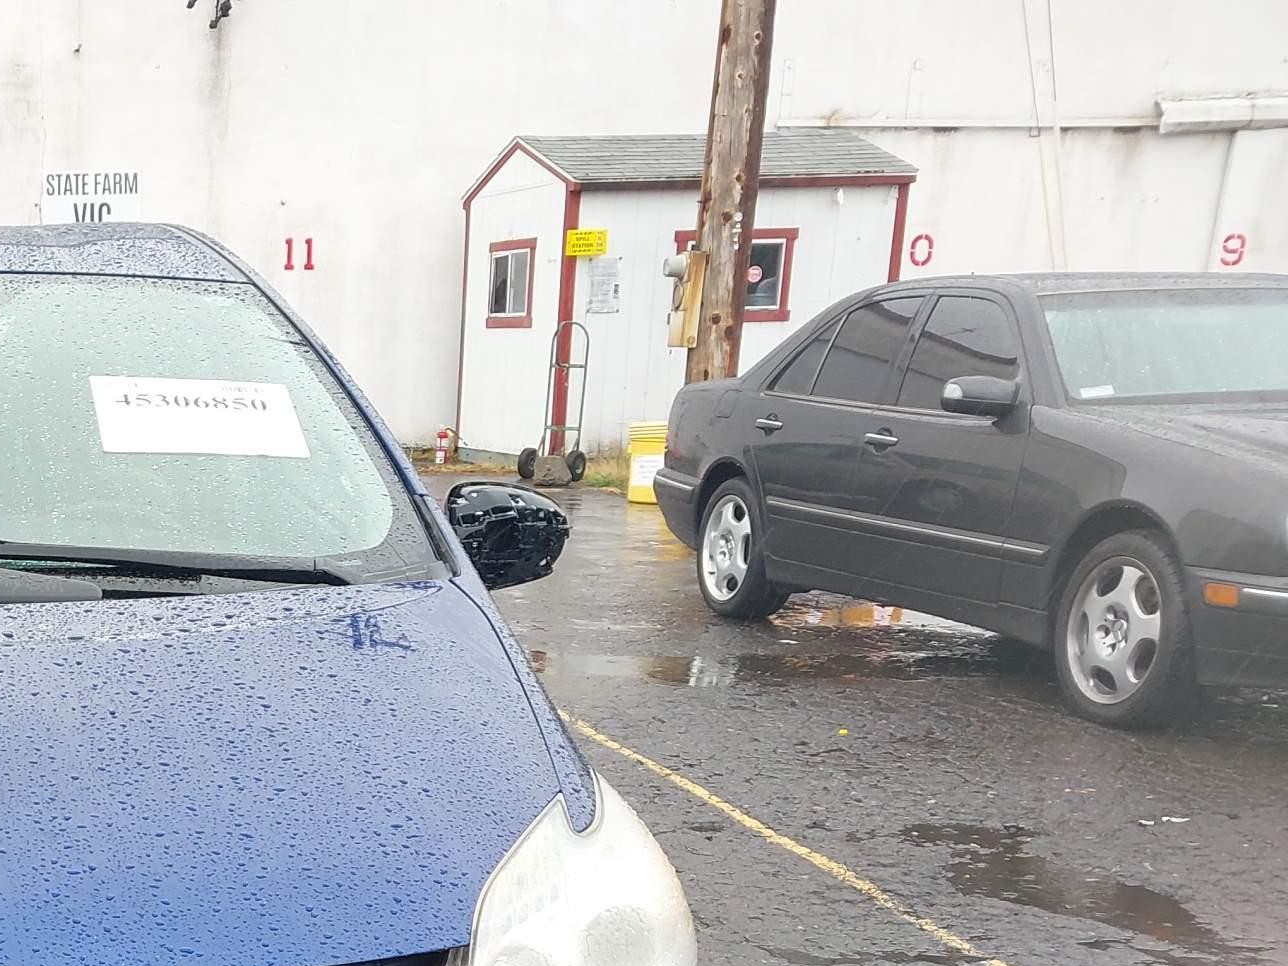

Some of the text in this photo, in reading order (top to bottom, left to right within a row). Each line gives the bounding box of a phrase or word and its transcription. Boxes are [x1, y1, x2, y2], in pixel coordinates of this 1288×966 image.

[45, 172, 139, 196] STATE FARM
[283, 238, 314, 271] 11
[1220, 233, 1247, 267] 9
[115, 394, 268, 411] 45306850
